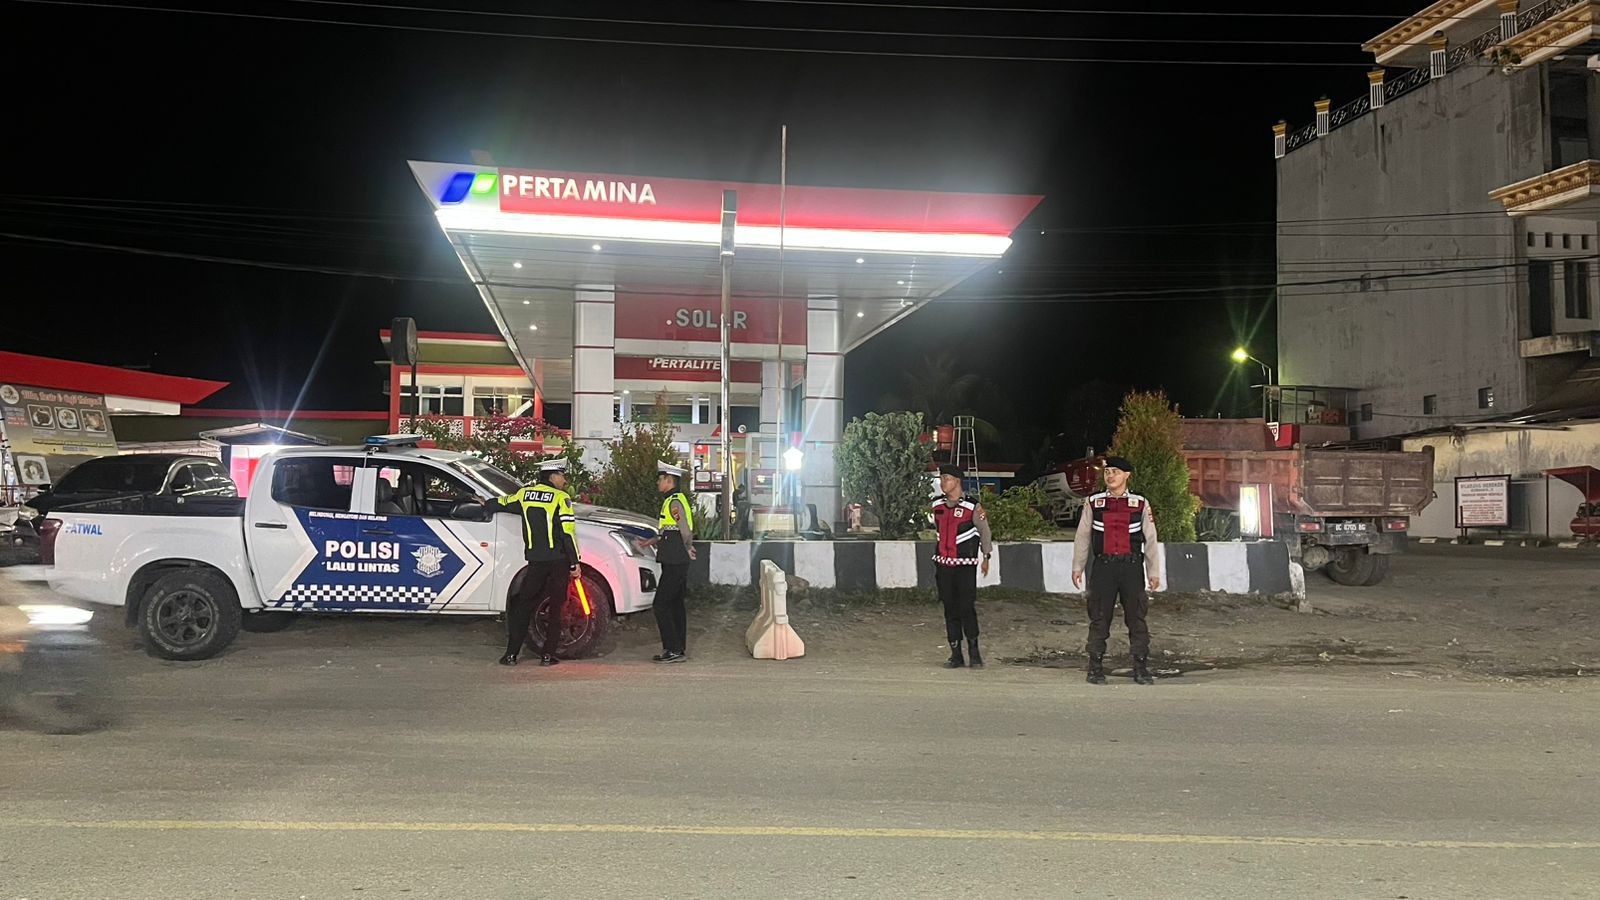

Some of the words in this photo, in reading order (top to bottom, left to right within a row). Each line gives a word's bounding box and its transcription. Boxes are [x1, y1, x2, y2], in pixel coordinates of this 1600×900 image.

[502, 174, 657, 206] PERTAMINA
[676, 308, 748, 330] SOLR
[652, 357, 721, 371] PERTALITE
[524, 491, 553, 503] POLISI
[325, 540, 400, 560] POLISI
[326, 561, 356, 572] LALU
[357, 563, 400, 574] LINTAS
